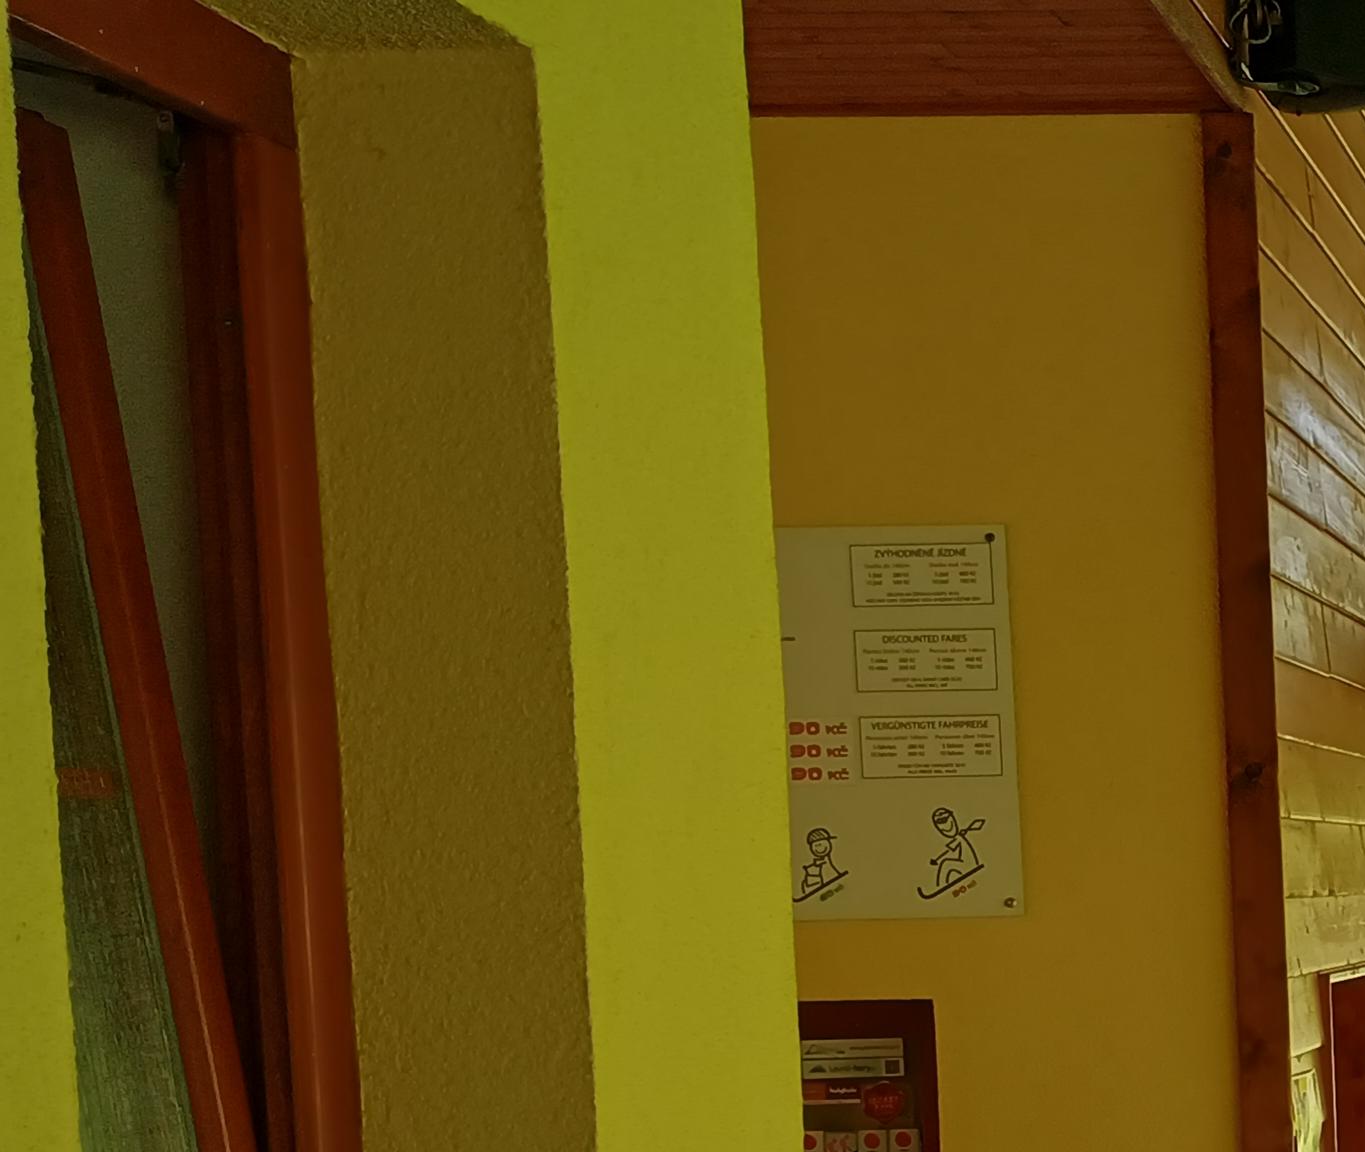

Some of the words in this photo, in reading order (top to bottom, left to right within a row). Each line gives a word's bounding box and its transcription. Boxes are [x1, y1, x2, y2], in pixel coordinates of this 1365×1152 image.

[882, 635, 940, 645] DISCOUNTED
[940, 634, 968, 643] FARES
[871, 720, 936, 731] VERGÜNSTIGTE
